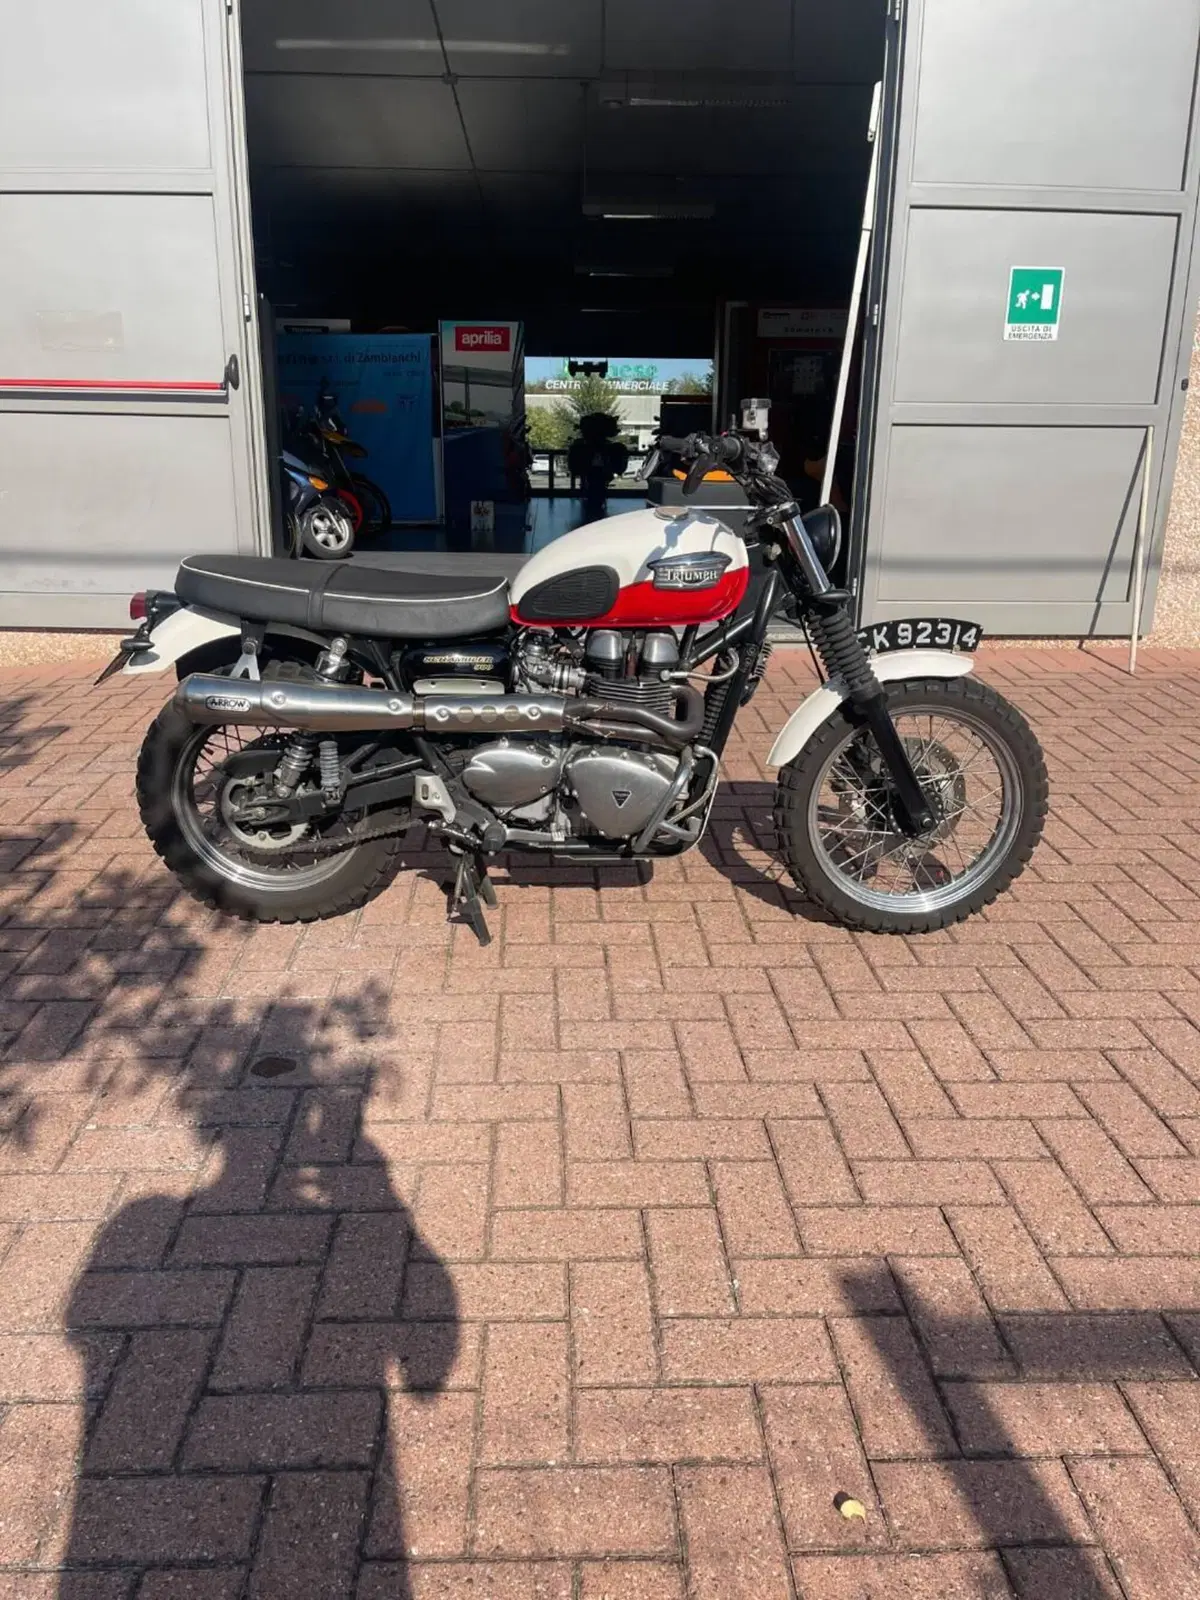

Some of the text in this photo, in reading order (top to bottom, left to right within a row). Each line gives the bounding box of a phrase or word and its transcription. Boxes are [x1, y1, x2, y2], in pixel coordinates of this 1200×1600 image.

[461, 330, 502, 347] aprilia
[665, 568, 717, 581] TRIUMPH
[857, 621, 978, 650] K 92314
[210, 698, 246, 708] ARROW
